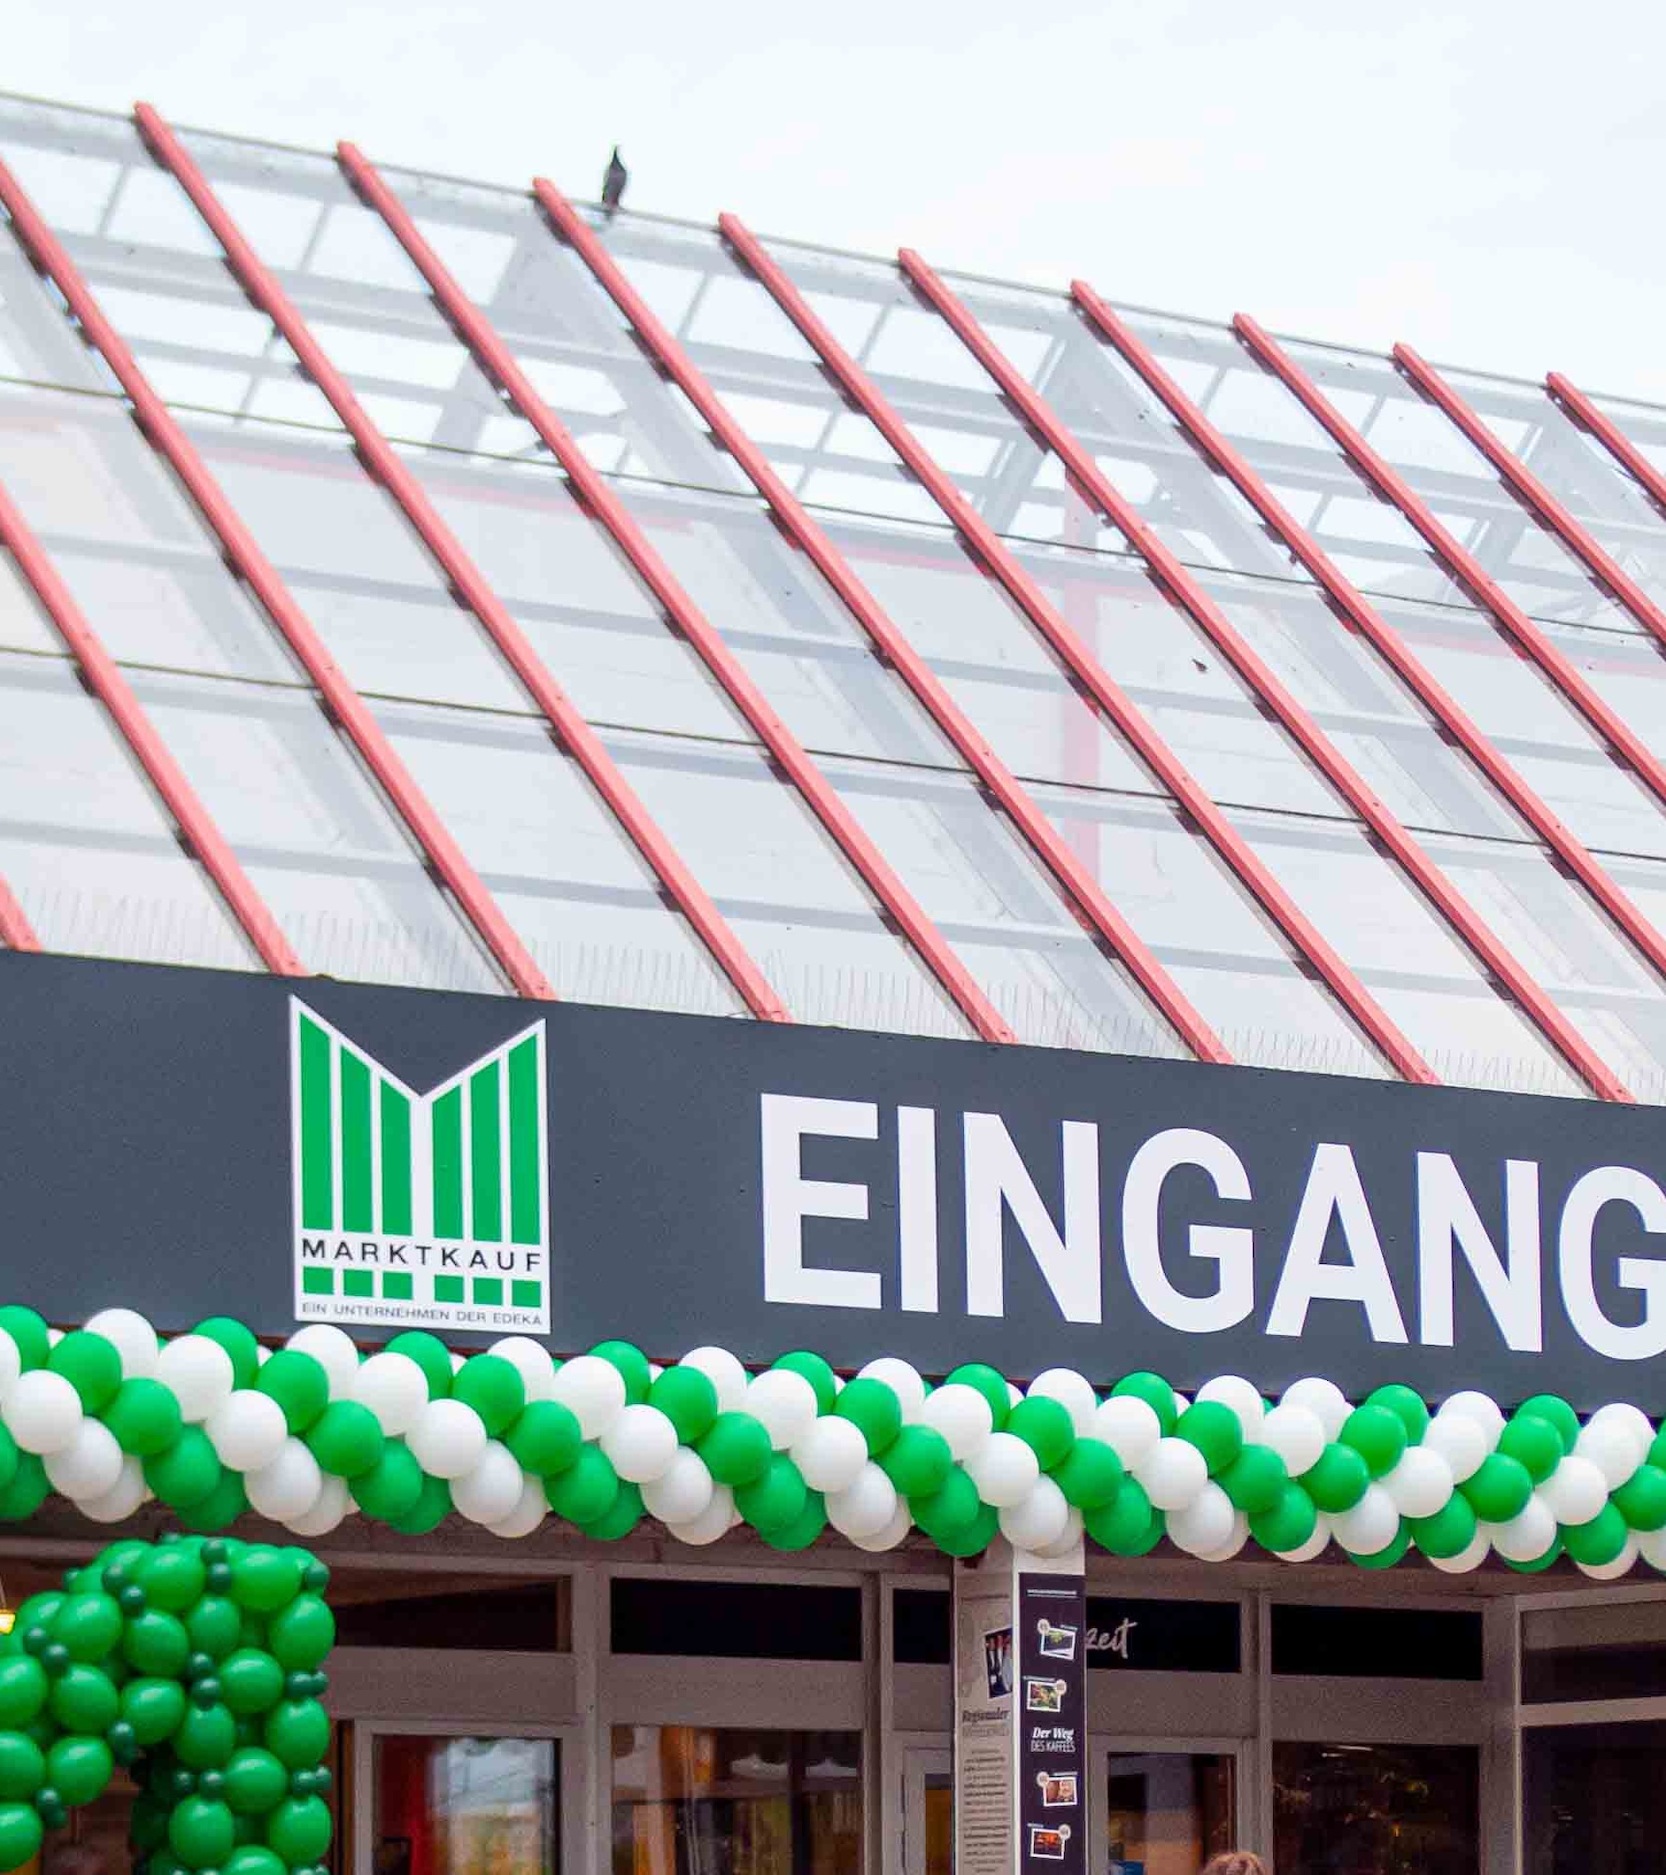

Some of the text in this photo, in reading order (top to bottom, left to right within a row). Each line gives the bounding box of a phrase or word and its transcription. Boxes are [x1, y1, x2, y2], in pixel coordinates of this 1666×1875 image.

[301, 1238, 541, 1272] MARKTKAUF
[301, 1302, 542, 1325] EIN UNTERNEHMEN DER EDEKA
[1033, 1727, 1051, 1739] Der
